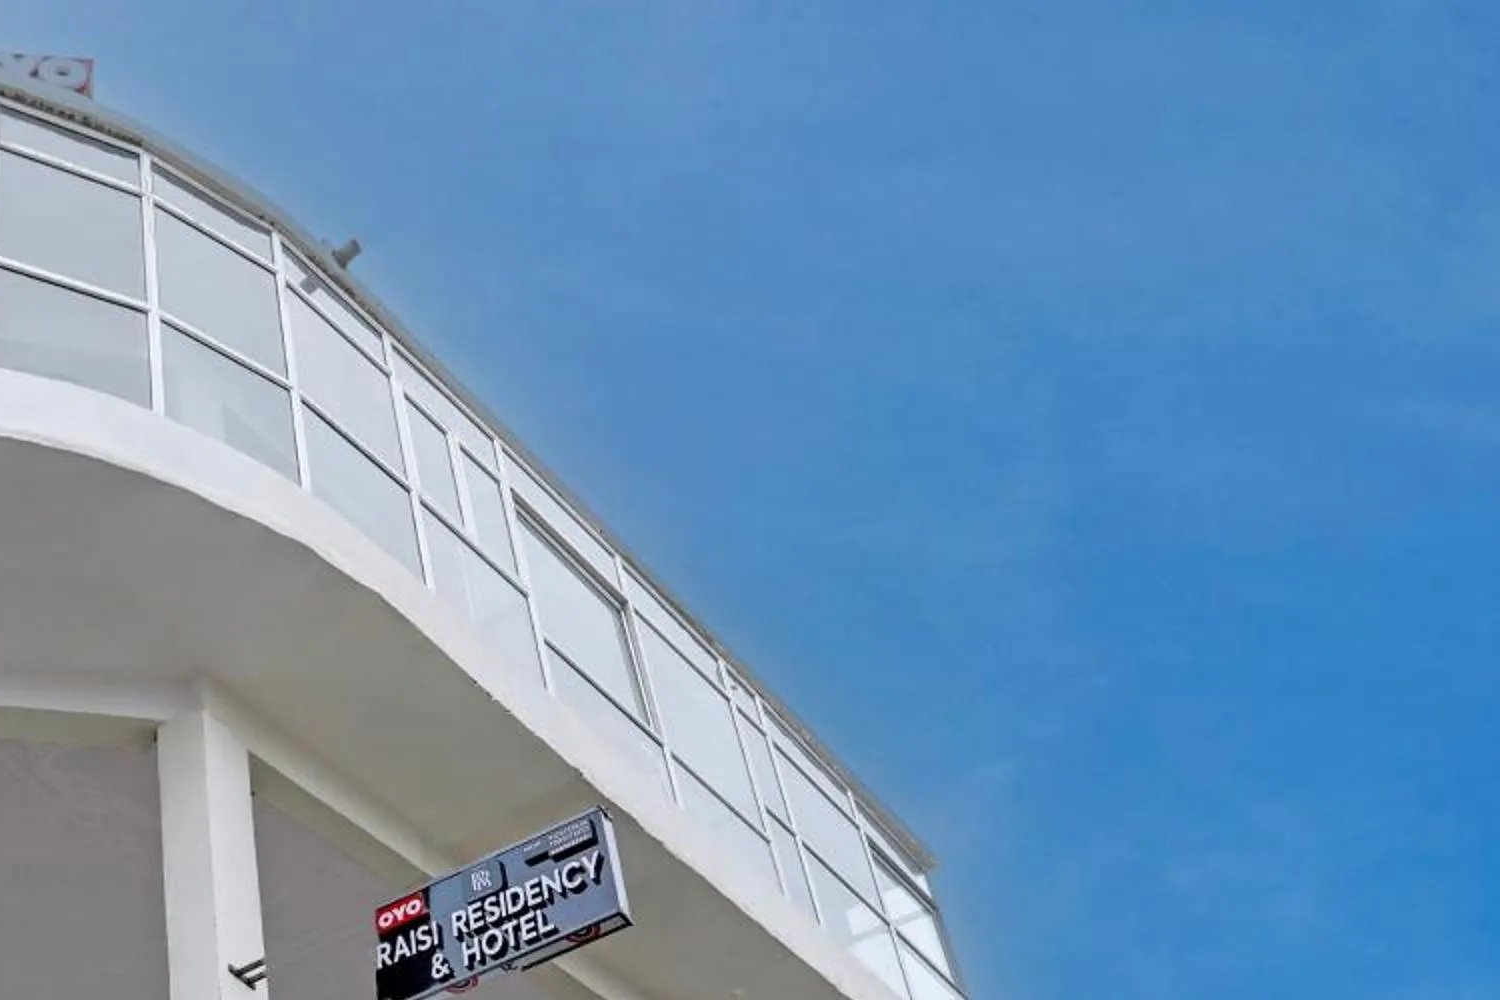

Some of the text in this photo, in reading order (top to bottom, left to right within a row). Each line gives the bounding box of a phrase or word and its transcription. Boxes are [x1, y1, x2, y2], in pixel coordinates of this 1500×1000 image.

[376, 850, 601, 969] RAISI RESIDENCY
[378, 899, 421, 928] OYO
[431, 911, 555, 979] & HOTEL
